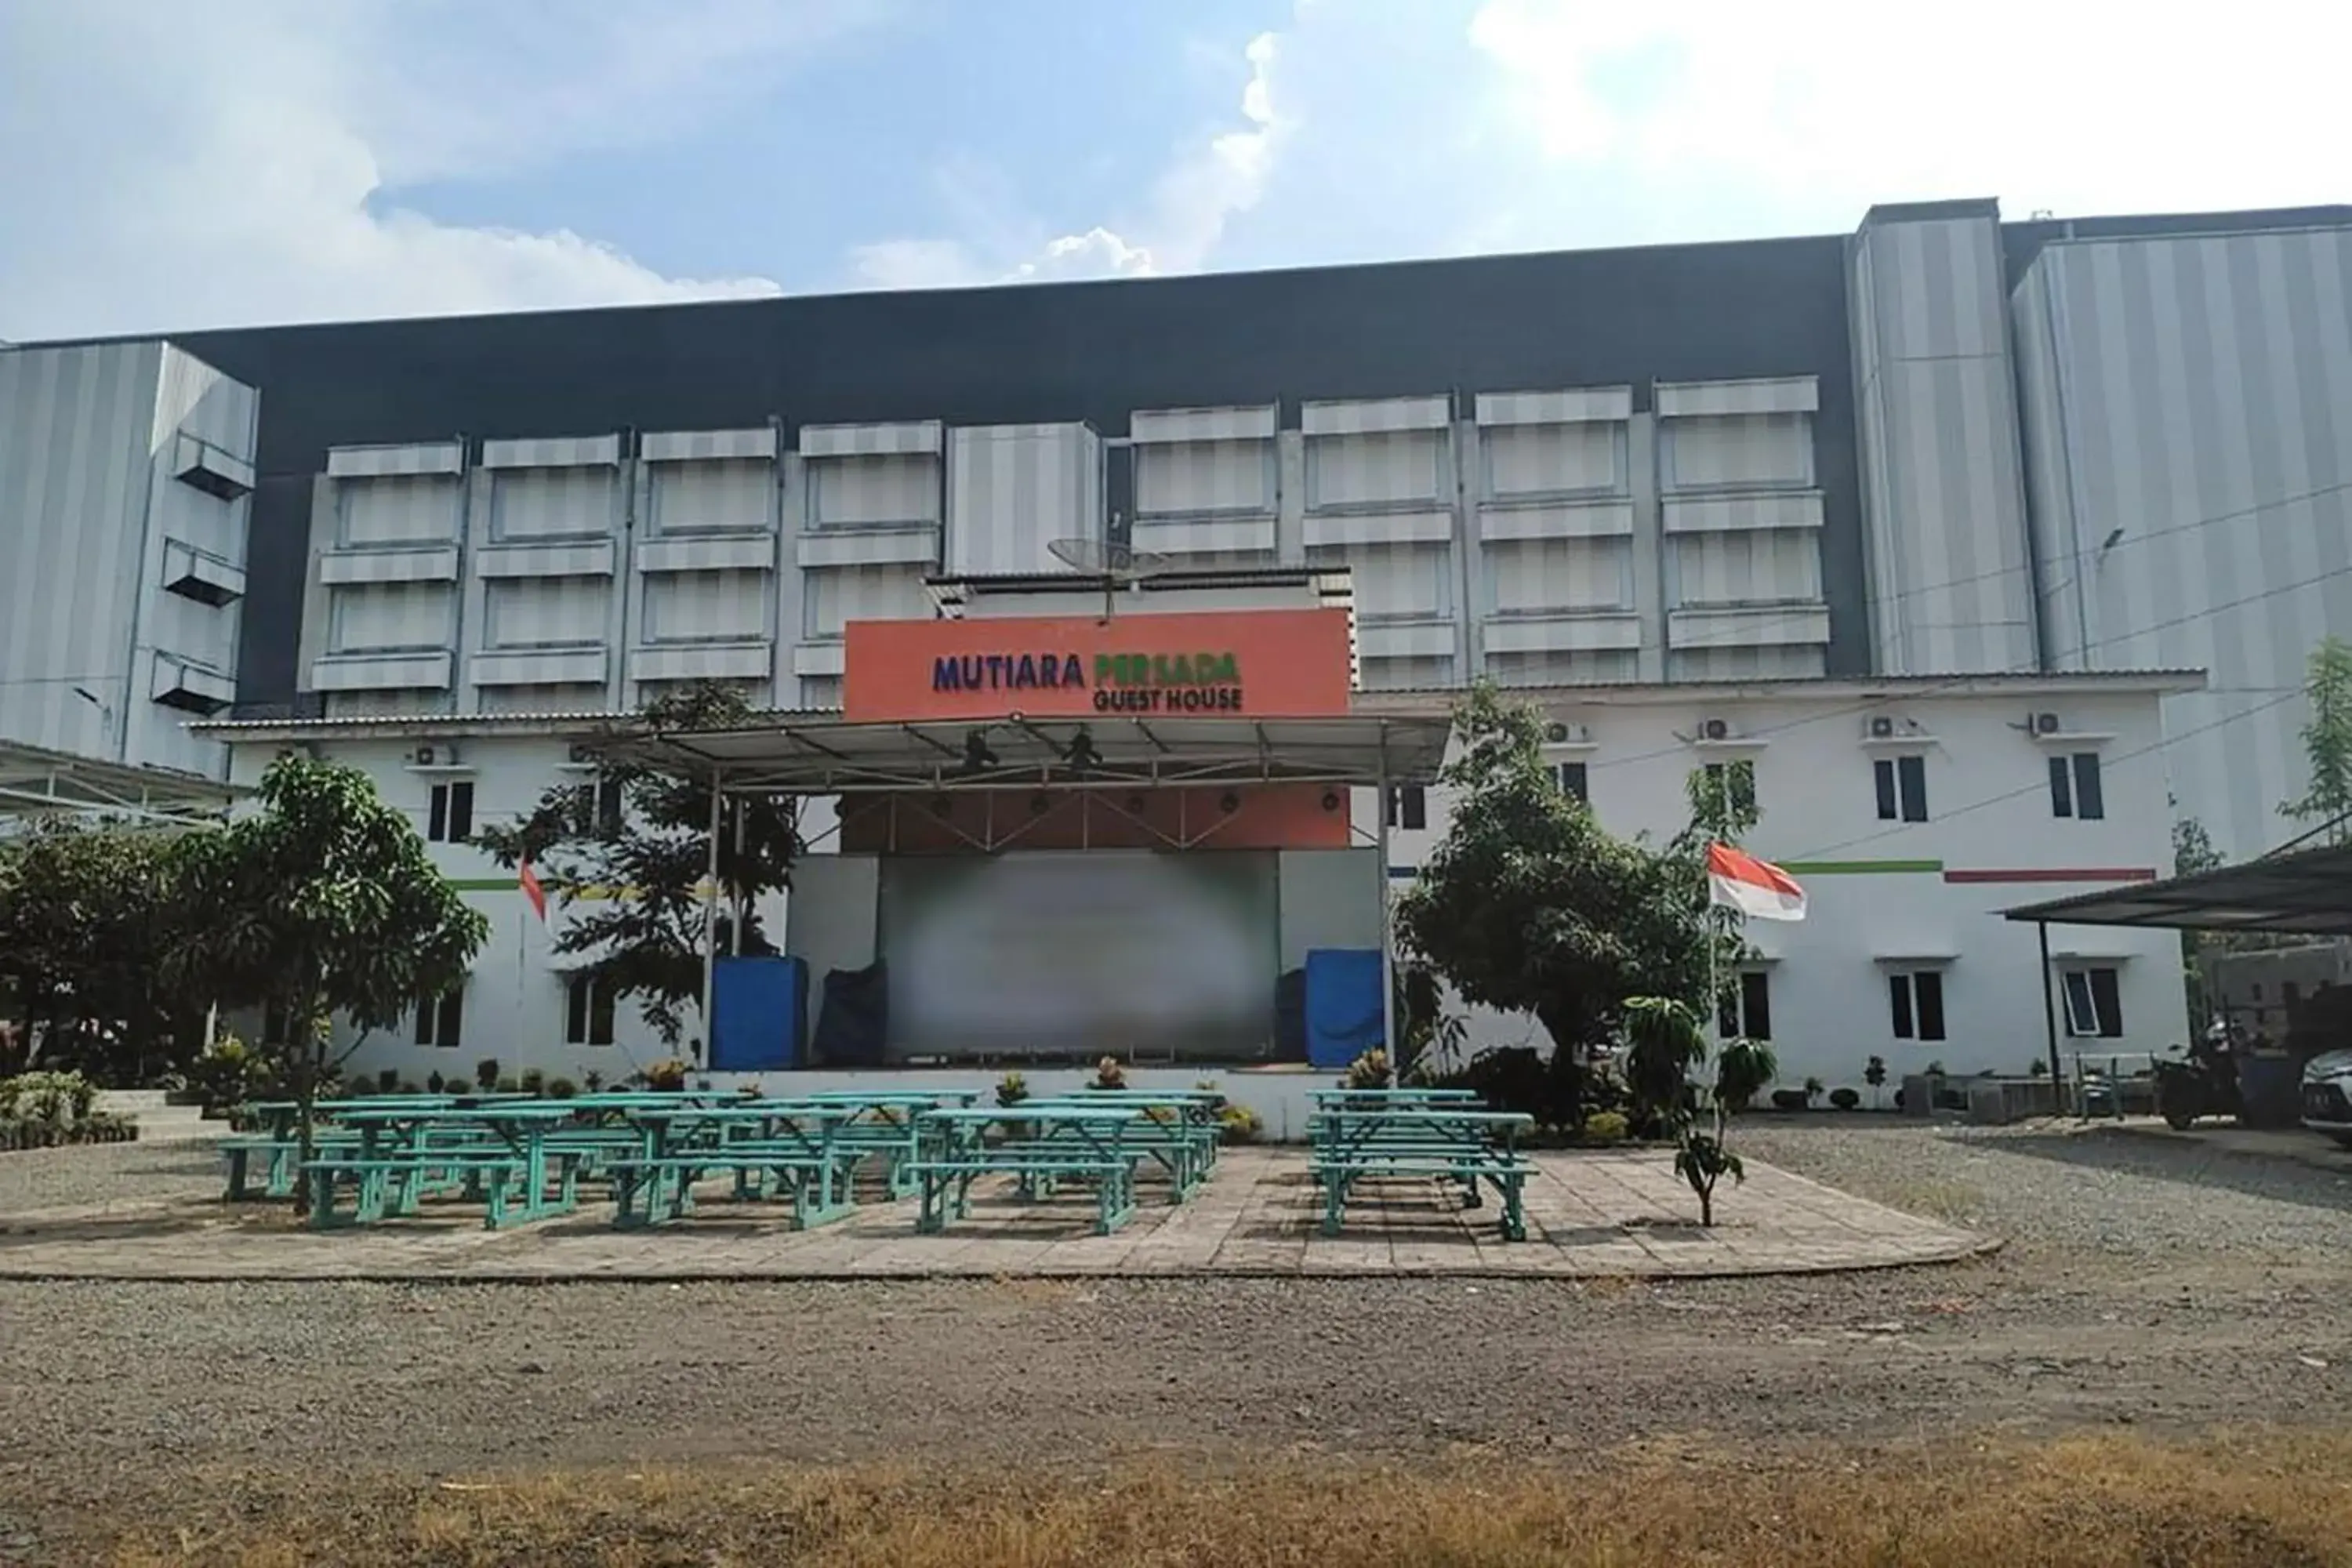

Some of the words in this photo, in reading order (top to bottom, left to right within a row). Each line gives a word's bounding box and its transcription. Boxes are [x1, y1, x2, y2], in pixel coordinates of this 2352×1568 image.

[933, 654, 1086, 692] MUTIARA
[1094, 652, 1241, 687] PERSADA
[1094, 689, 1160, 712] GUEST
[1166, 688, 1243, 710] HOUSE
